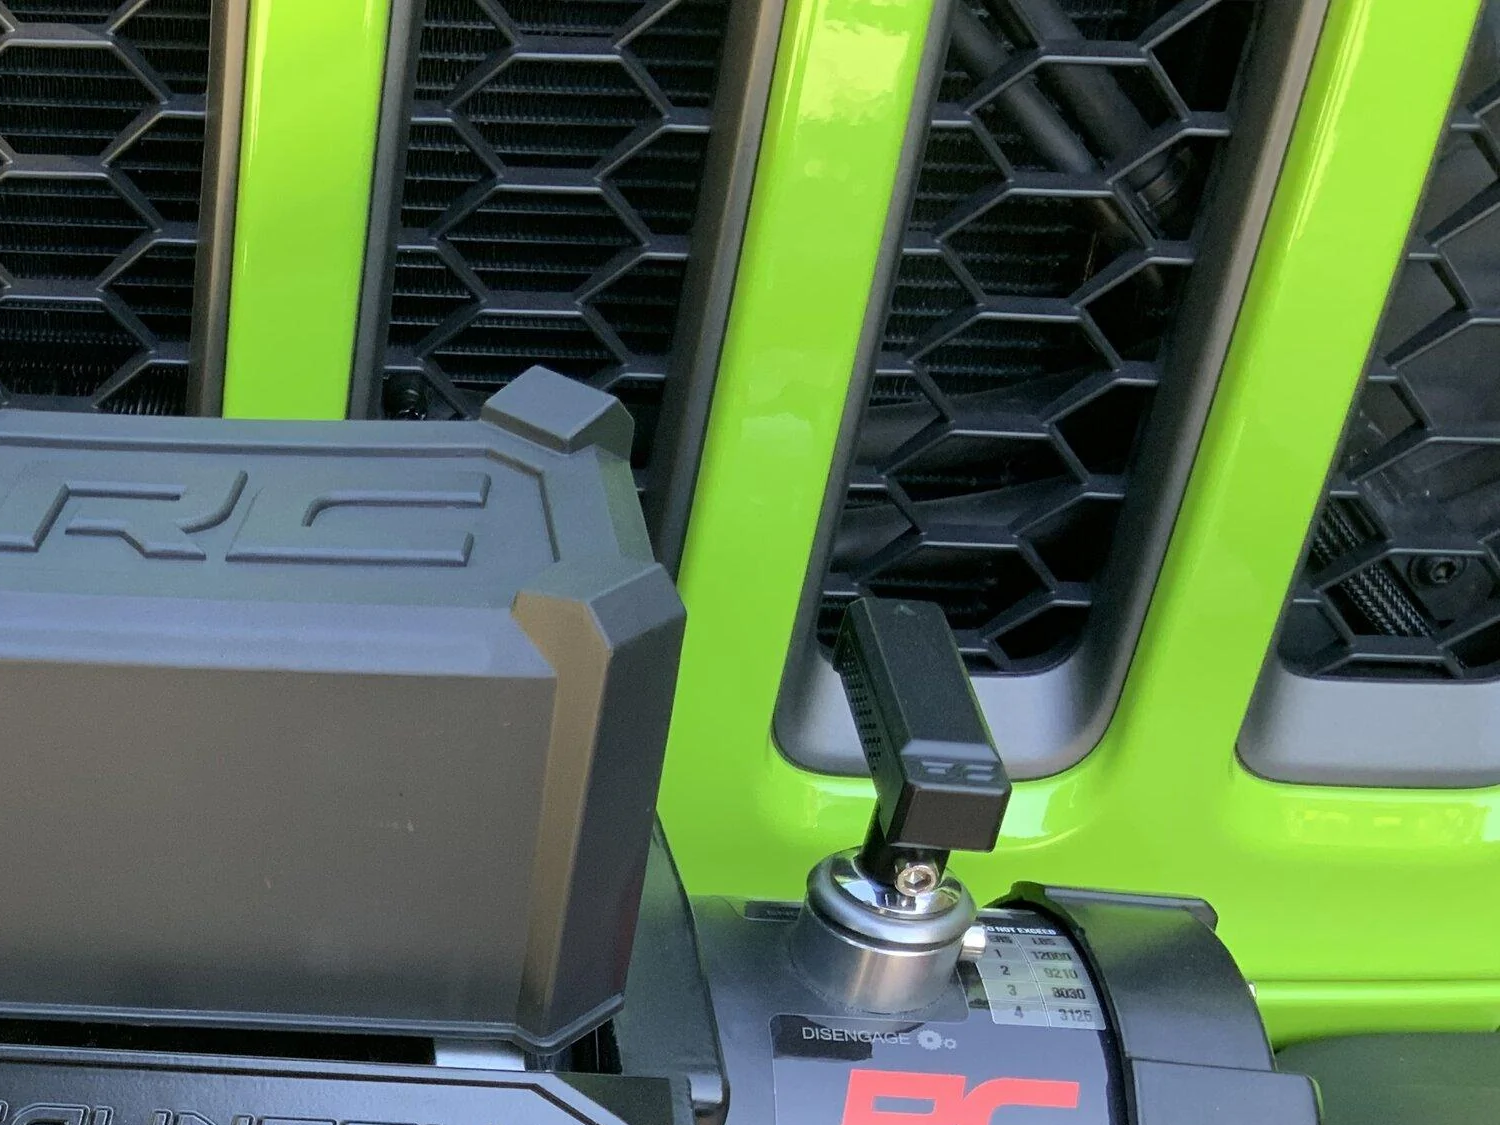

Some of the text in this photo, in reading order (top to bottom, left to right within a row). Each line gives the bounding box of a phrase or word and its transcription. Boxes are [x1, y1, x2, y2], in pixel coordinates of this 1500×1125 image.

[1019, 927, 1057, 935] EXCEED
[994, 949, 1002, 958] 1
[1000, 965, 1078, 979] 2 9210
[1007, 984, 1017, 996] 3
[1014, 1005, 1024, 1018] 4
[802, 1027, 911, 1045] DISENGAGE
